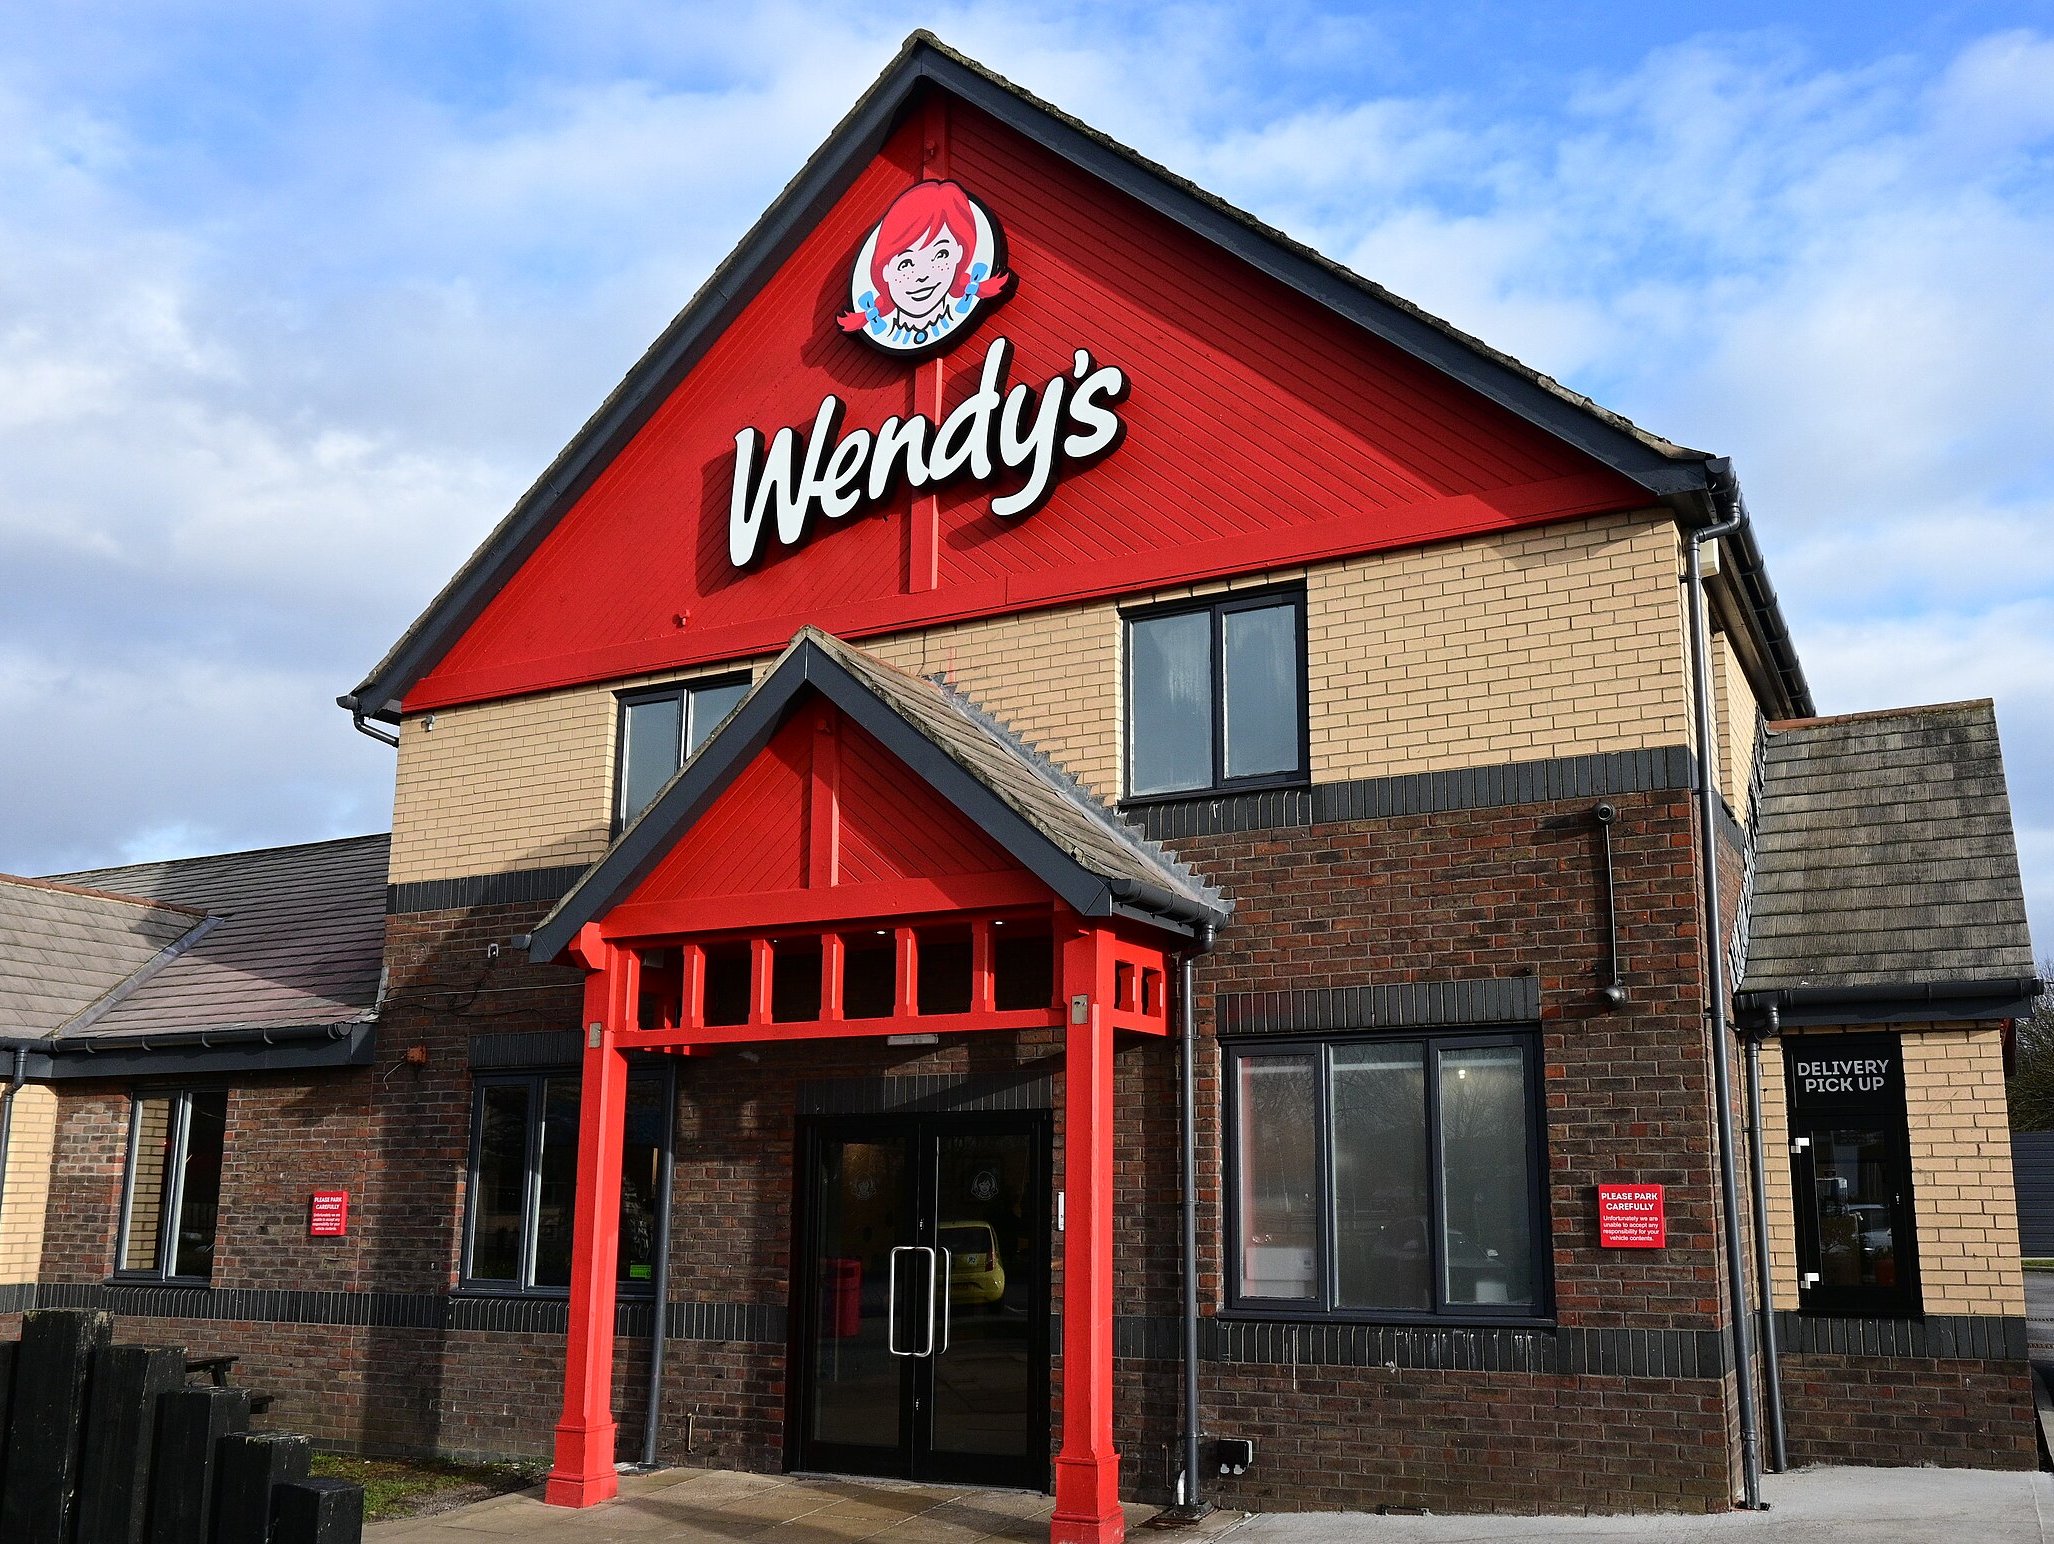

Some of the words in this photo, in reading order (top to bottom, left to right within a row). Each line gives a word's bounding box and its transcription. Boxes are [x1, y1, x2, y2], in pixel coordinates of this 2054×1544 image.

[730, 337, 1124, 567] Wendy's
[1797, 1059, 1889, 1076] DELIVERY
[1805, 1077, 1853, 1093] PICK
[1858, 1076, 1885, 1091] UP
[1601, 1192, 1633, 1200] PLEASE
[1634, 1192, 1658, 1200] PARK
